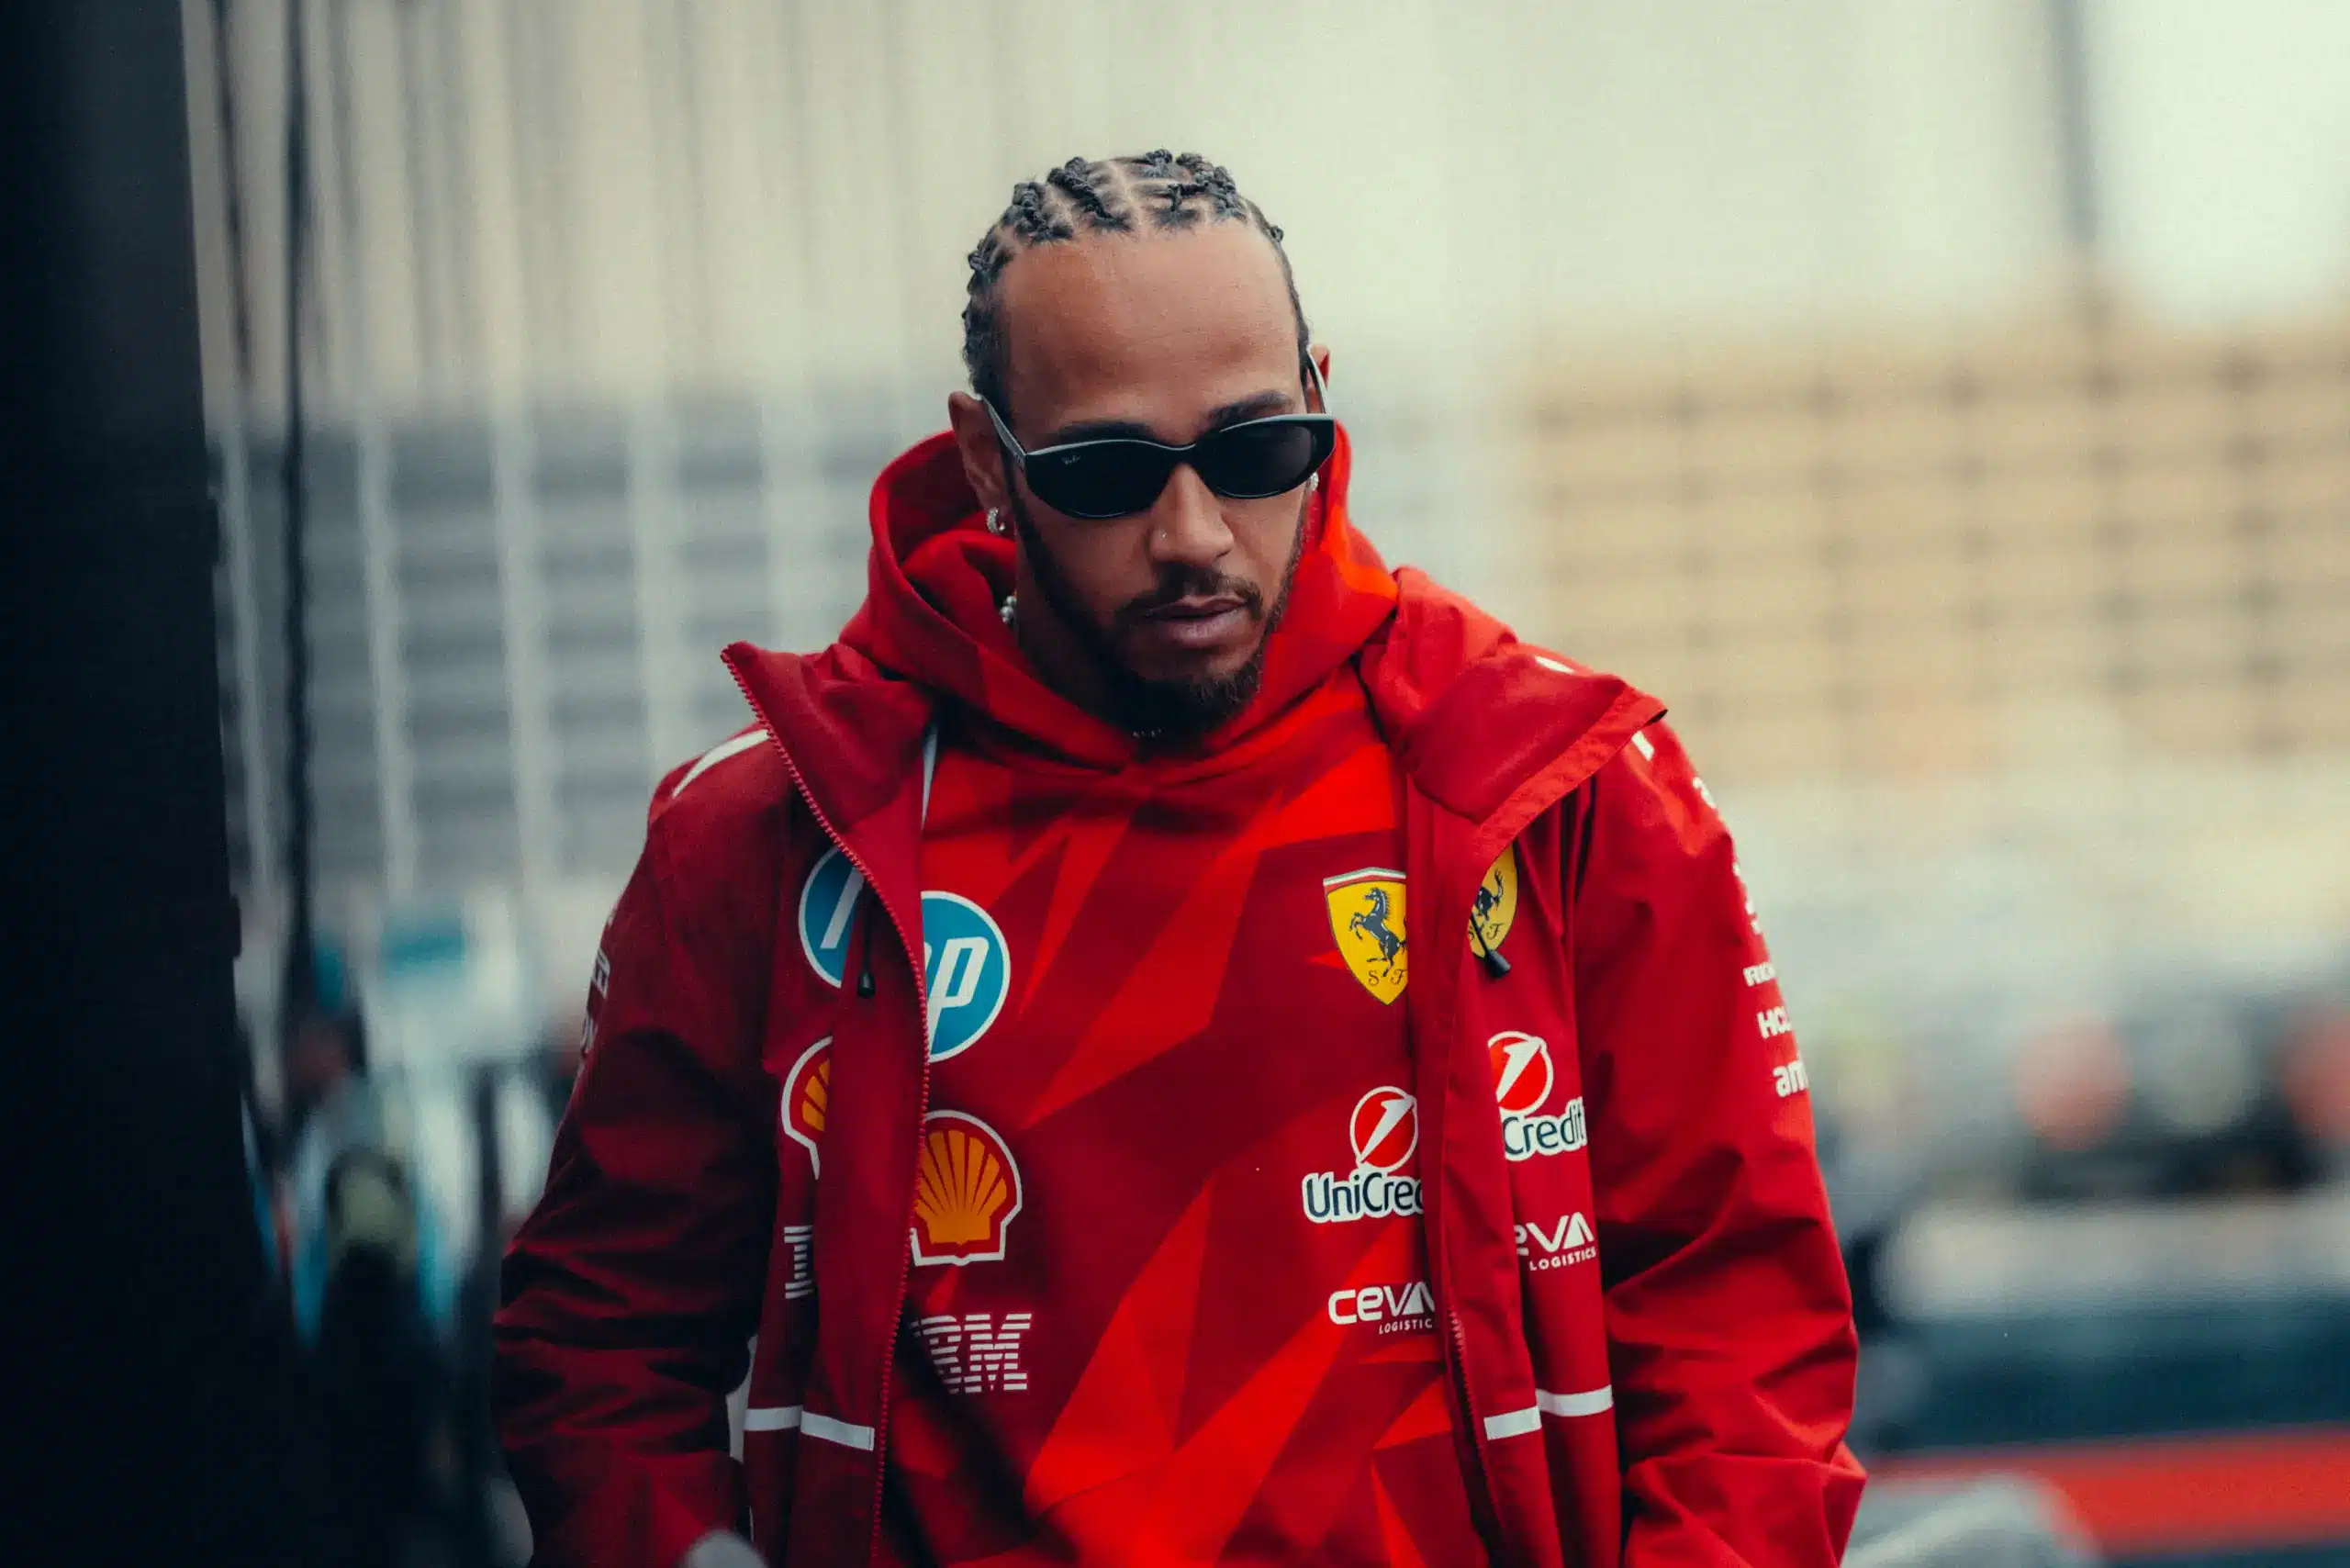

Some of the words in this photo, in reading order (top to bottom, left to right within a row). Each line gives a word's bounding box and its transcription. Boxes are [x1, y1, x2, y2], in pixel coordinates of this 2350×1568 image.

[924, 937, 990, 1055] p
[1503, 1103, 1584, 1155] Credit
[1307, 1171, 1423, 1217] UniCre
[1528, 1247, 1596, 1271] LOGISTICS
[1379, 1317, 1433, 1334] LOGISTIC
[911, 1313, 1032, 1394] BM
